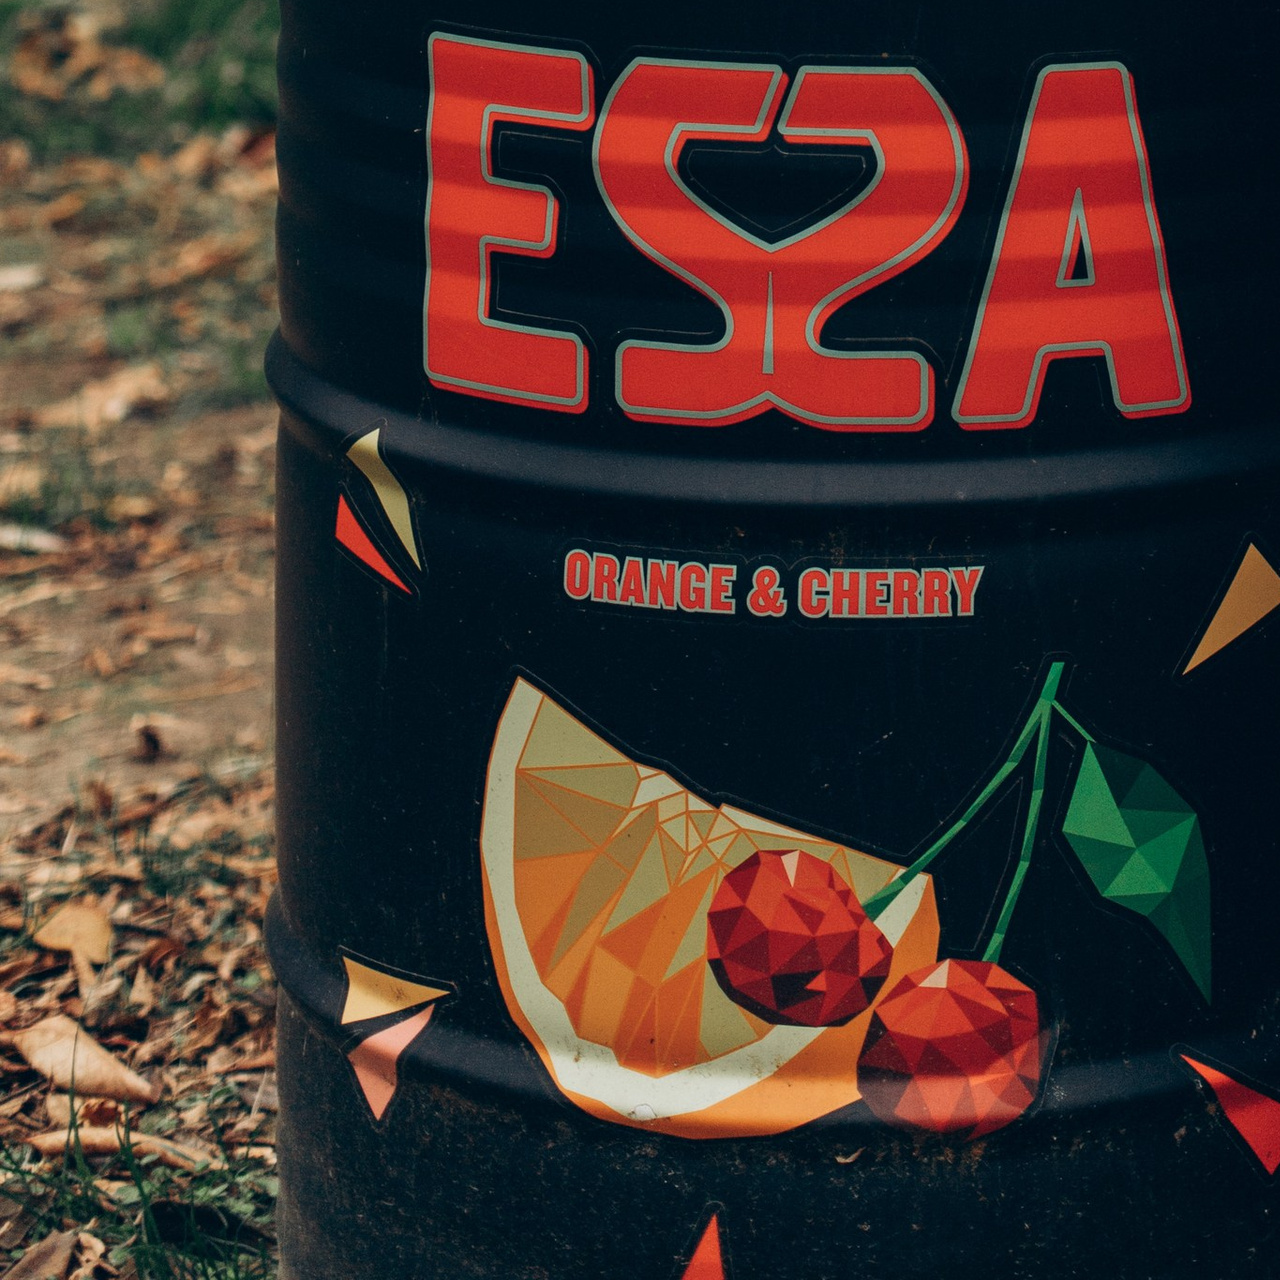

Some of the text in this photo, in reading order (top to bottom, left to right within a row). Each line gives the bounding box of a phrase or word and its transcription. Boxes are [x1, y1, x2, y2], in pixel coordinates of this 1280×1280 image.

[563, 548, 985, 619] ORANGE & CHERRY
